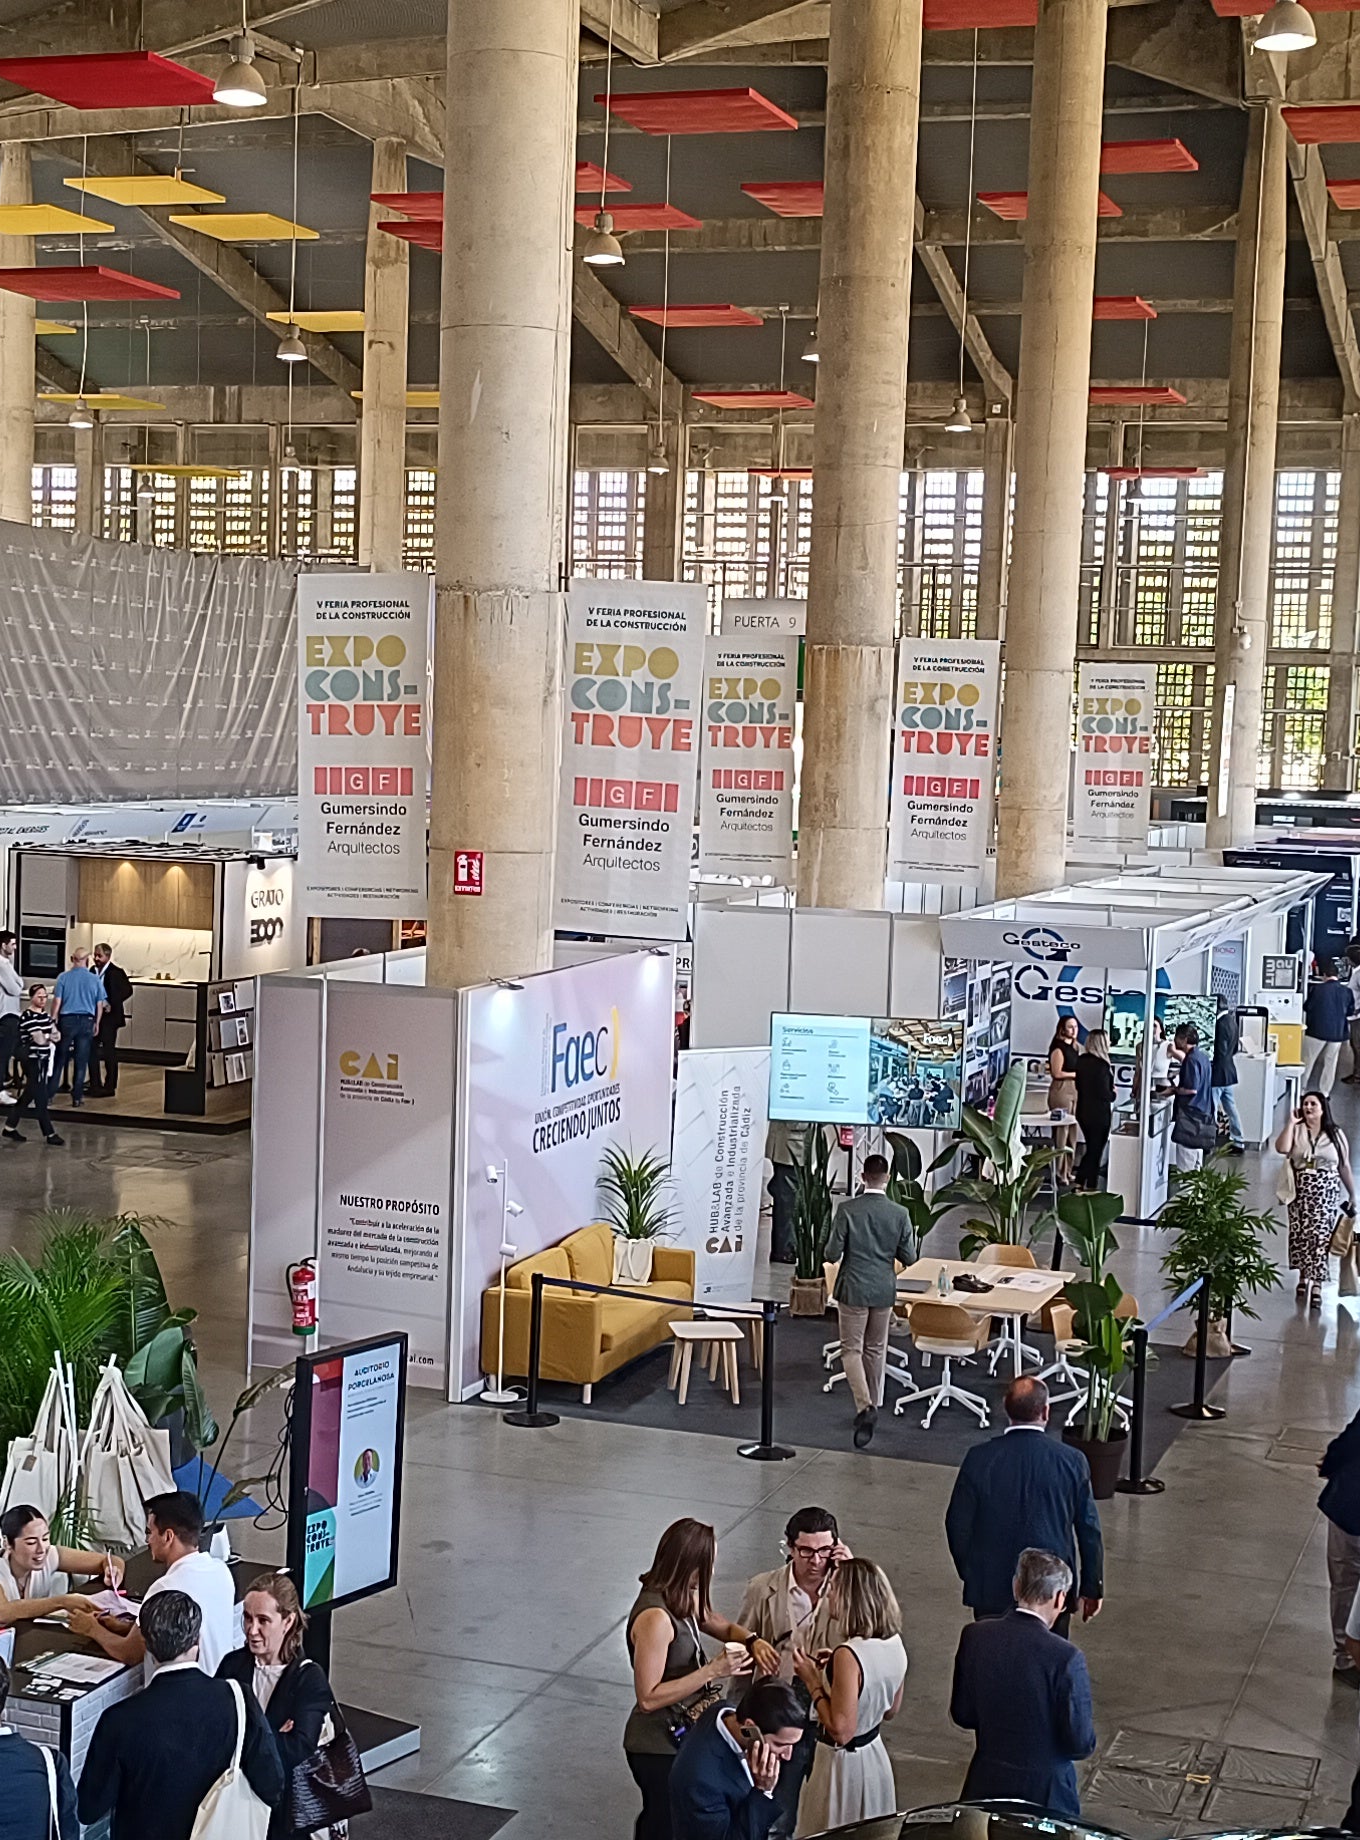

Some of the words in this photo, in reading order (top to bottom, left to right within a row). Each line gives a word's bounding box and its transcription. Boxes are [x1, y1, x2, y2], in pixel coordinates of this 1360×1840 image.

[342, 609, 410, 619] CONSTRUCCIÓN
[351, 600, 410, 609] PROFESIONAL
[596, 607, 621, 616] FERIA
[623, 609, 686, 619] PROFESIONAL
[586, 618, 597, 626] DE
[600, 619, 611, 627] LA
[613, 620, 686, 631] CONSTRUCCIÓN
[734, 615, 779, 627] PUERTA
[789, 617, 796, 628] 9
[306, 635, 406, 667] EXPO
[574, 642, 679, 680] EXPO
[304, 669, 418, 702] CONS-
[709, 678, 781, 700] EXPO
[904, 681, 979, 707] EXPO
[571, 677, 690, 715] CONS-
[306, 704, 421, 736] TRUYE
[571, 712, 693, 752] TRUYE
[708, 725, 792, 749] TRUYE
[902, 730, 989, 757] TRUYE
[320, 802, 407, 817] Gumersindo
[716, 794, 779, 805] Gumersindo
[907, 800, 974, 813] Gumersindo
[578, 813, 670, 832] Gumersindo
[720, 808, 774, 819] Fernández
[910, 814, 968, 828] Fernández
[326, 820, 400, 836] Fernández
[720, 821, 773, 833] Arquitectos
[910, 828, 967, 841] Arquitectos
[327, 840, 400, 856] Arquitectos
[583, 833, 662, 853] Fernández
[583, 853, 660, 871] Arquitectos
[1003, 932, 1080, 950] Gesteco
[1014, 964, 1150, 1004] Gest
[533, 1110, 586, 1153] CRECIENDO
[586, 1098, 621, 1139] JUNTOS
[715, 1090, 729, 1163] Construcción
[726, 1086, 741, 1168] Industrializada
[740, 1107, 752, 1138] Cádiz
[738, 1157, 748, 1203] provincia
[340, 1194, 383, 1209] NUESTRO
[385, 1199, 439, 1215] PROPÓSITO
[709, 1182, 722, 1234] HUB&LAB
[721, 1181, 734, 1233] Avanzada
[348, 1372, 394, 1391] PORCELANOSA
